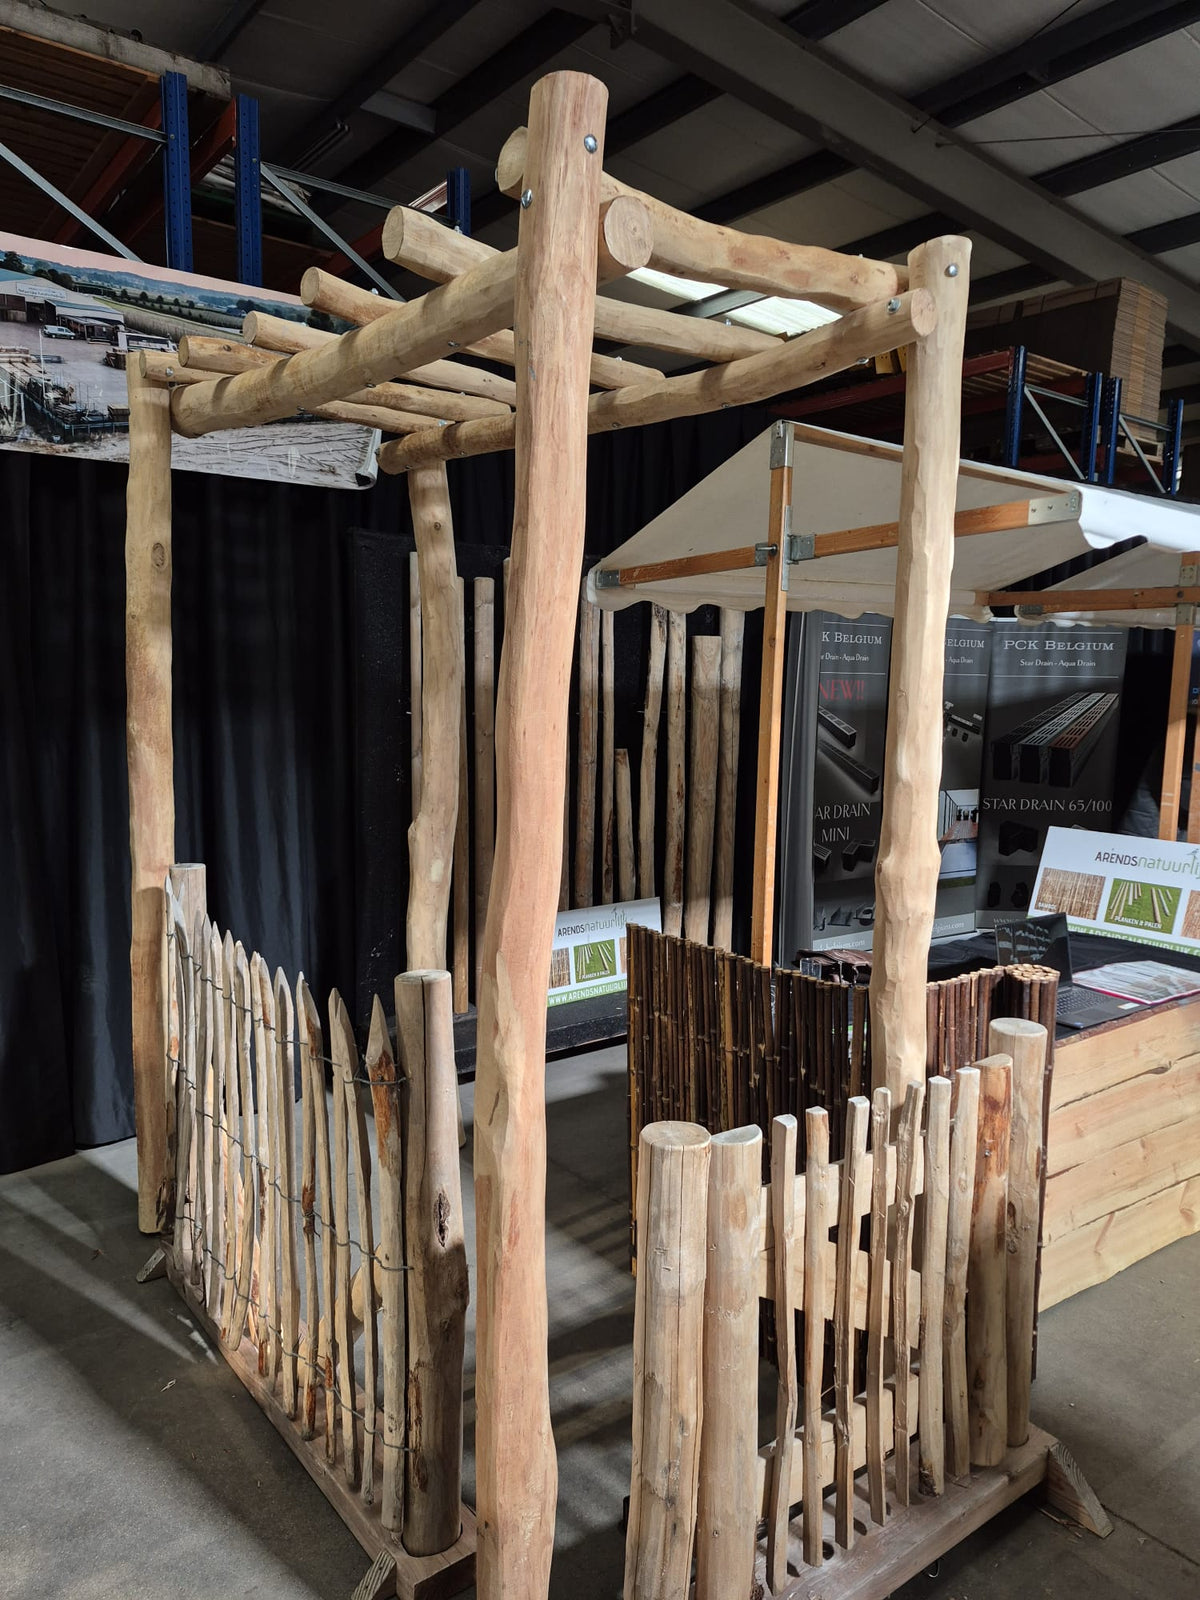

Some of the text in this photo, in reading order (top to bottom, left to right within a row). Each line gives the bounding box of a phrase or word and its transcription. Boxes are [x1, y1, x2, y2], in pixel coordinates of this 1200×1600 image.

[834, 632, 882, 645] BELGIUM
[946, 638, 985, 648] ELGIUM
[1003, 640, 1115, 651] PCK BELGIUM
[843, 653, 855, 662] Aqua
[1020, 659, 1034, 667] Star
[1035, 659, 1054, 667] Drain
[1059, 659, 1076, 668] Aqua
[1077, 659, 1096, 668] Drain
[819, 679, 865, 700] NEW!!
[815, 802, 871, 820] AR DRAIN
[982, 797, 1112, 812] STAR DRAIN 65/100
[821, 826, 850, 843] MINI
